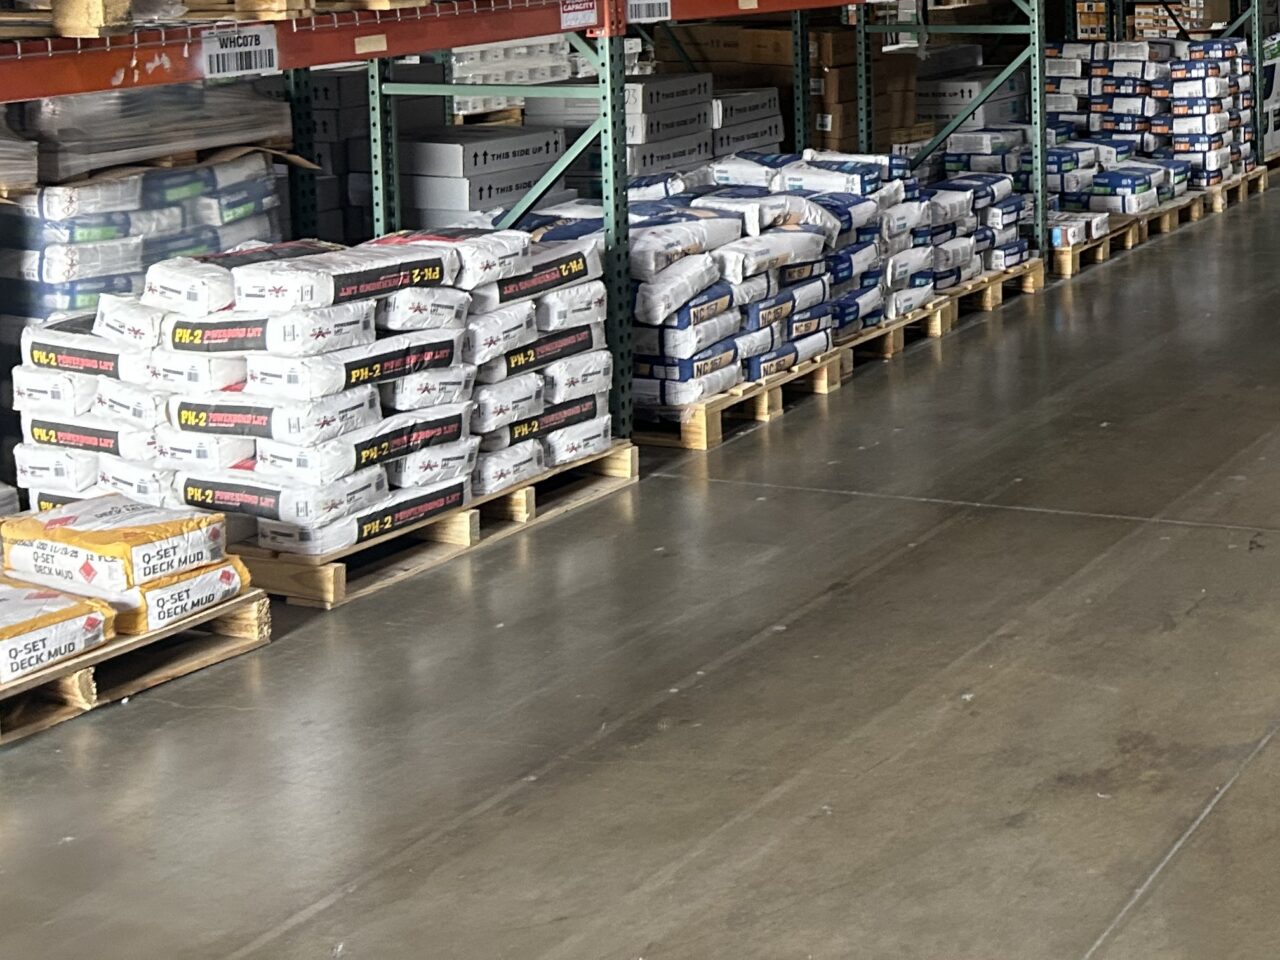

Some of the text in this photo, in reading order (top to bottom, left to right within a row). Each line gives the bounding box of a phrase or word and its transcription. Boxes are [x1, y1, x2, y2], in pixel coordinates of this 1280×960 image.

[563, 2, 594, 11] CAPACITY
[219, 34, 261, 49] WHC07B
[491, 146, 543, 161] THIS SIDE UP
[656, 153, 671, 161] THIS
[672, 150, 686, 158] SIDE
[495, 181, 532, 194] THIS SIDE
[692, 309, 705, 324] NC
[761, 311, 771, 327] NC
[175, 328, 203, 344] PH-2
[794, 323, 804, 334] NC
[32, 350, 57, 366] PH-2
[509, 350, 535, 368] PH-2
[350, 363, 382, 384] PH-2
[696, 362, 709, 377] NC
[762, 362, 773, 377] NC
[181, 410, 207, 427] PH-2
[32, 427, 57, 443] PH-2
[513, 420, 539, 439] PH-2
[360, 442, 390, 464] PH-2
[187, 487, 213, 504] PH-2
[362, 515, 393, 538] PH-2
[33, 552, 55, 564] Q-SET
[142, 544, 178, 565] Q-SET
[34, 564, 73, 580] DECK MUD
[143, 550, 204, 578] DECK MUD
[156, 588, 191, 608] Q-SET
[158, 593, 215, 621] DECK MUD
[8, 638, 48, 659] Q-SET
[10, 642, 76, 673] DECK MUD
